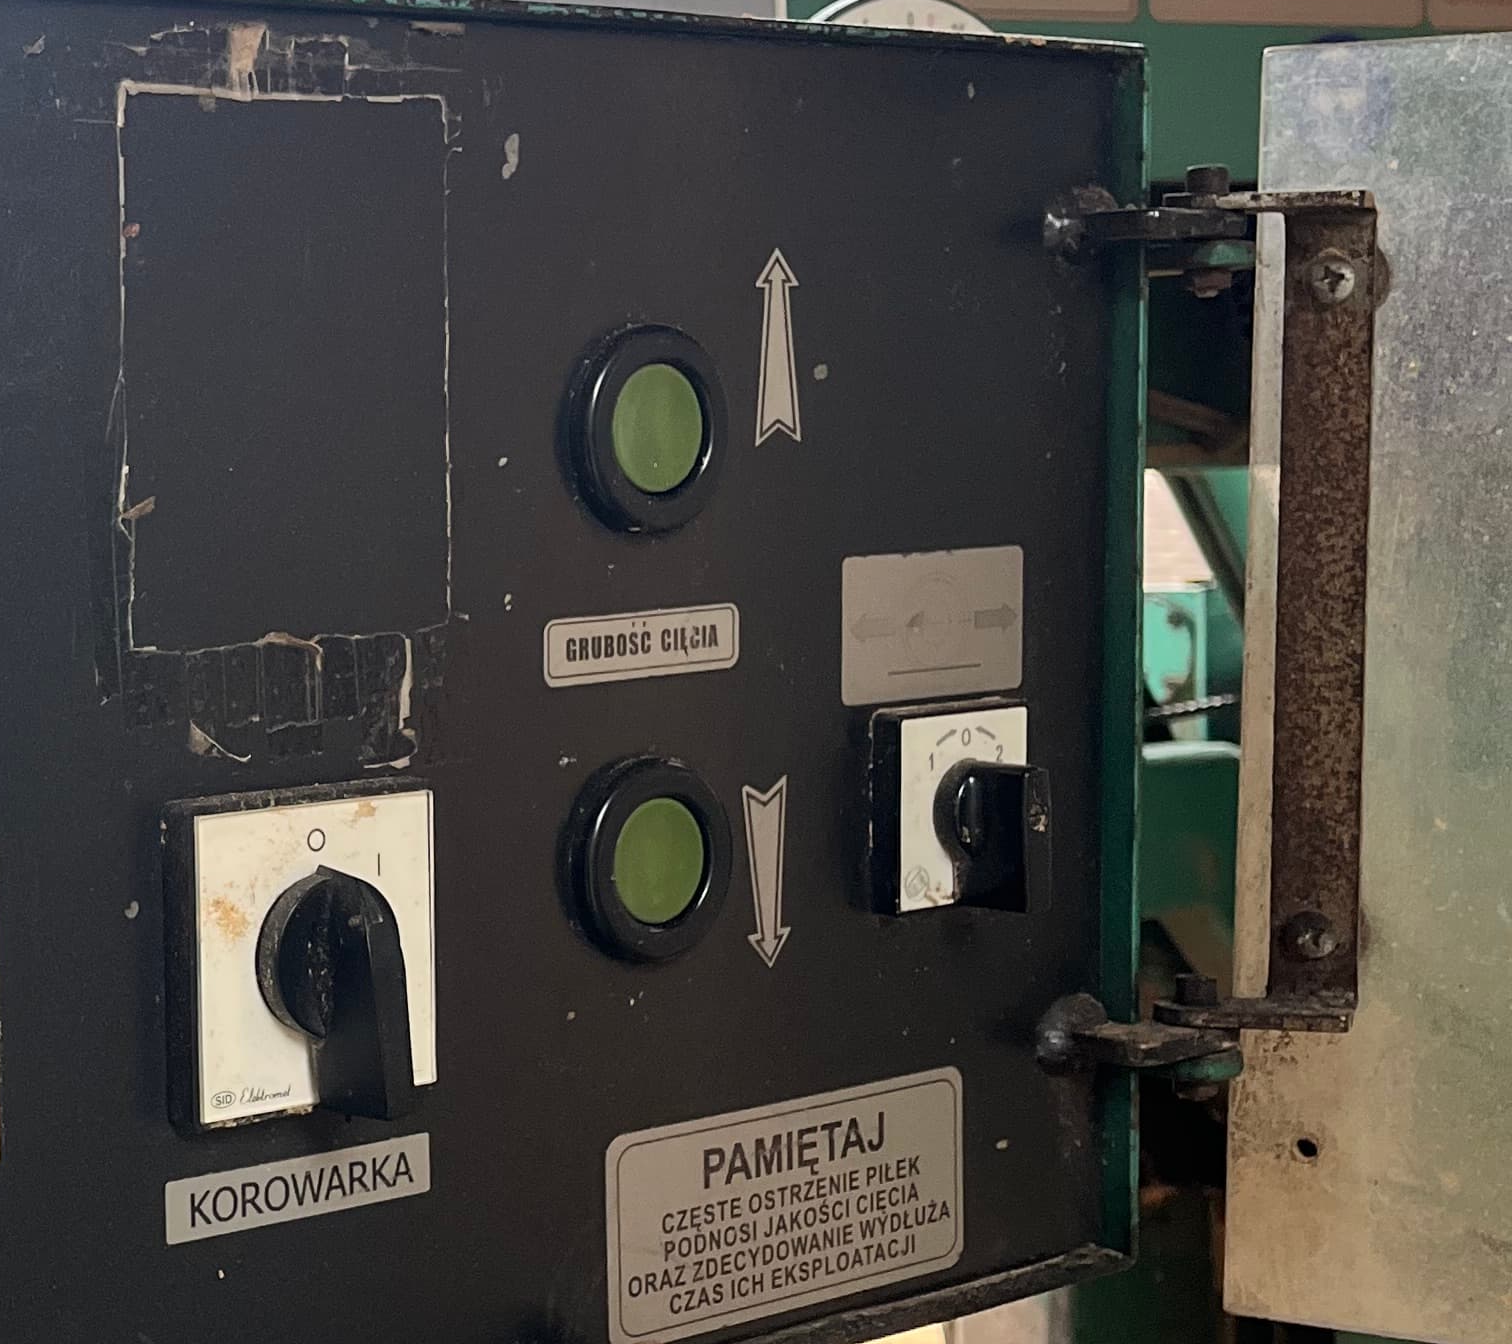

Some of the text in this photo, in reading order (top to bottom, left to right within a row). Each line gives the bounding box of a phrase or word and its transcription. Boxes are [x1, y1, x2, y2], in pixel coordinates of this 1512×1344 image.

[566, 621, 651, 662] GRUBOŚĆ
[928, 752, 934, 771] 1
[996, 745, 1003, 763] 2
[216, 1094, 233, 1106] SID
[703, 1111, 886, 1190] PAMIĘTAJ
[189, 1151, 414, 1229] KOROWARKA
[662, 1156, 921, 1234] CZĘSTE OSTRZENIE PIŁEK
[664, 1182, 919, 1261] PODNOSI JAKOŚCI CIĘCIA
[628, 1200, 951, 1297] ORAZ ZDECYDOWANIE WYDŁUŻA
[670, 1234, 915, 1314] CZAS ICH EKSPLOATACJI
